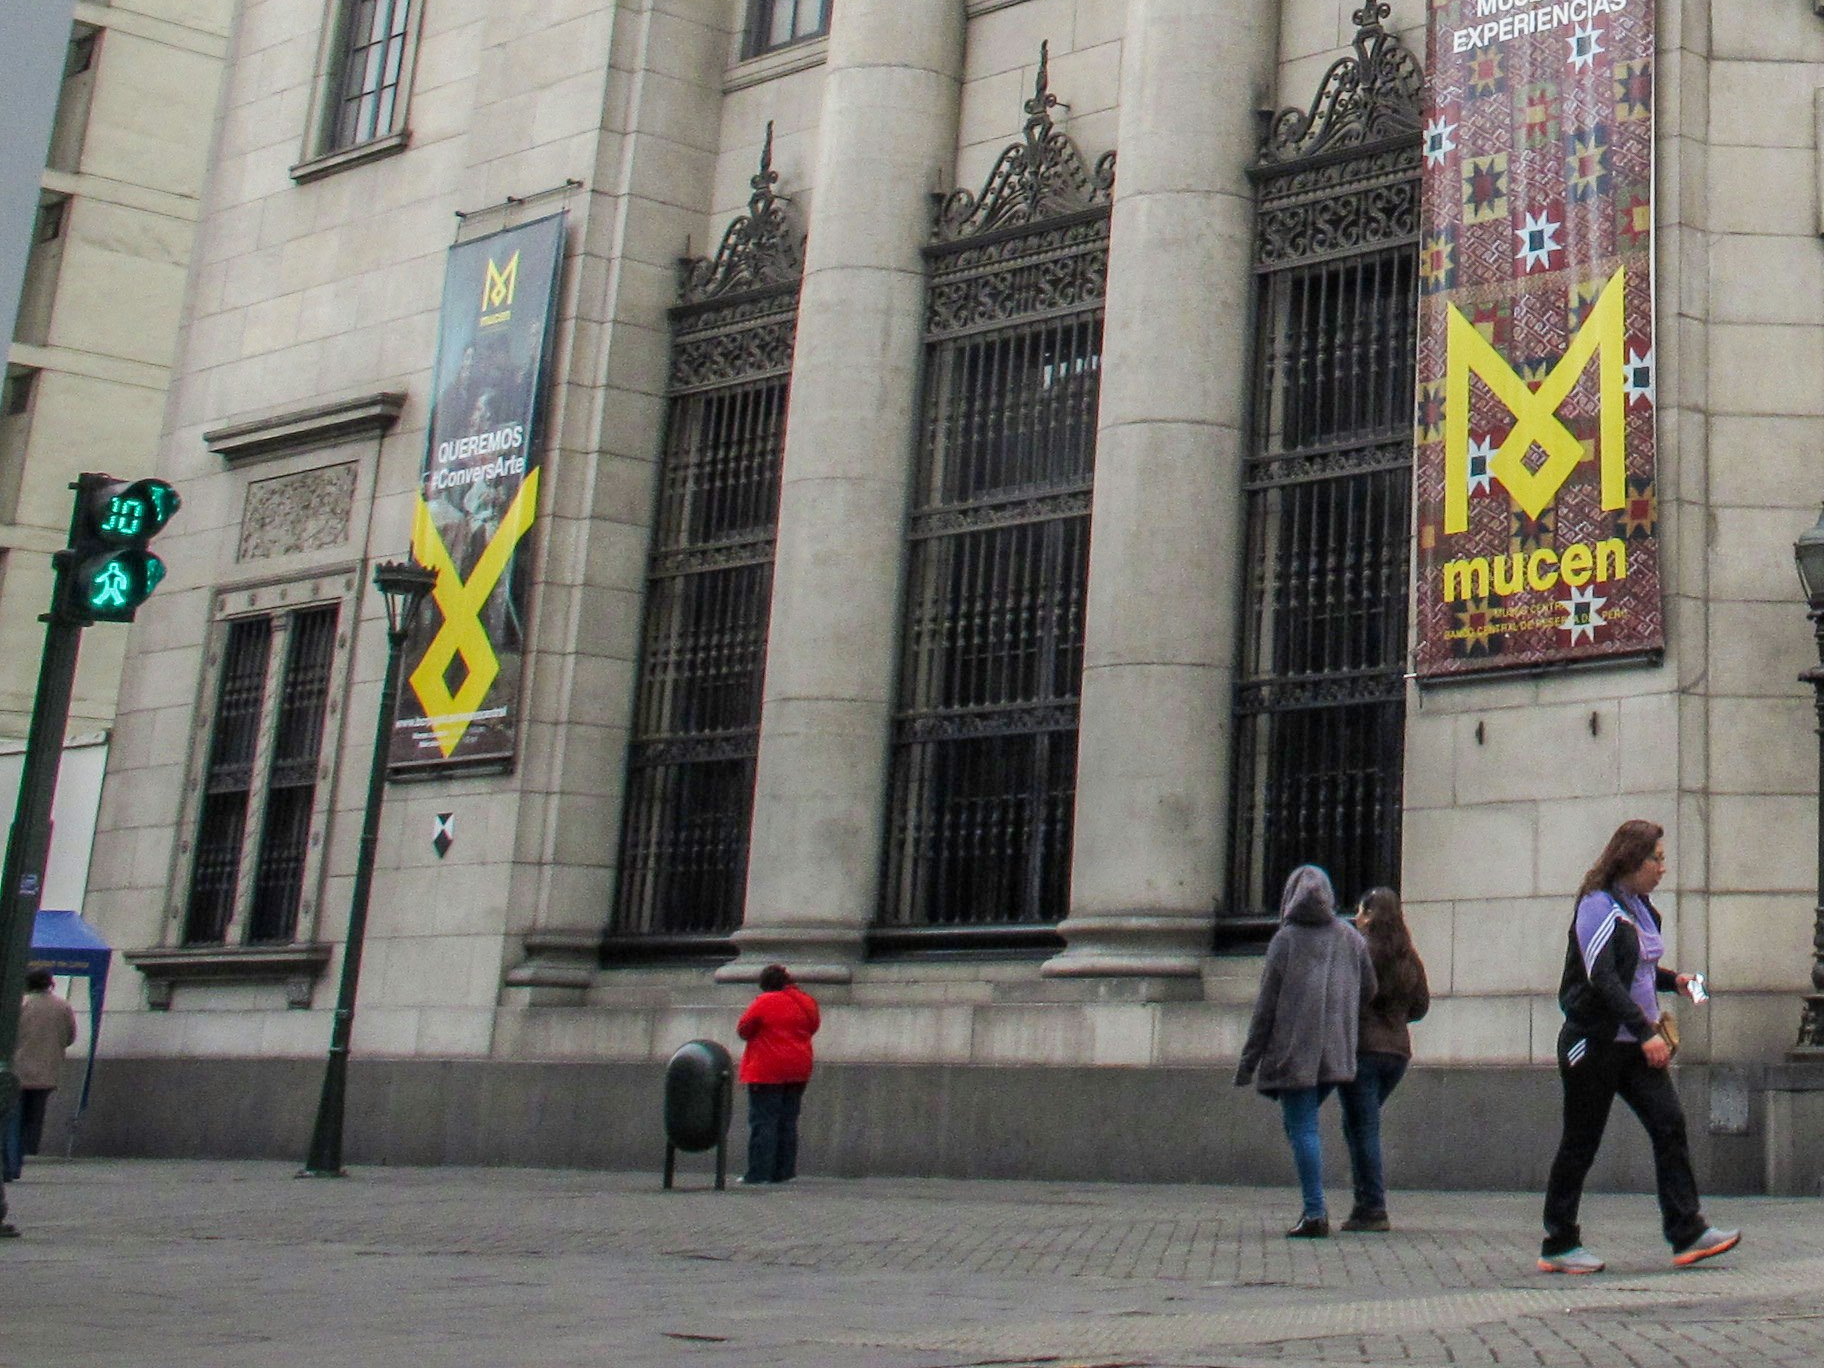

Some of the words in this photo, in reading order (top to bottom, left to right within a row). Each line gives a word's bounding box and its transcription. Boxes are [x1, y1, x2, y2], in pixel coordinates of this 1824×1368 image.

[438, 425, 524, 464] QUEREMOS
[430, 454, 525, 490] #ConversArte
[1443, 537, 1627, 603] mucen
